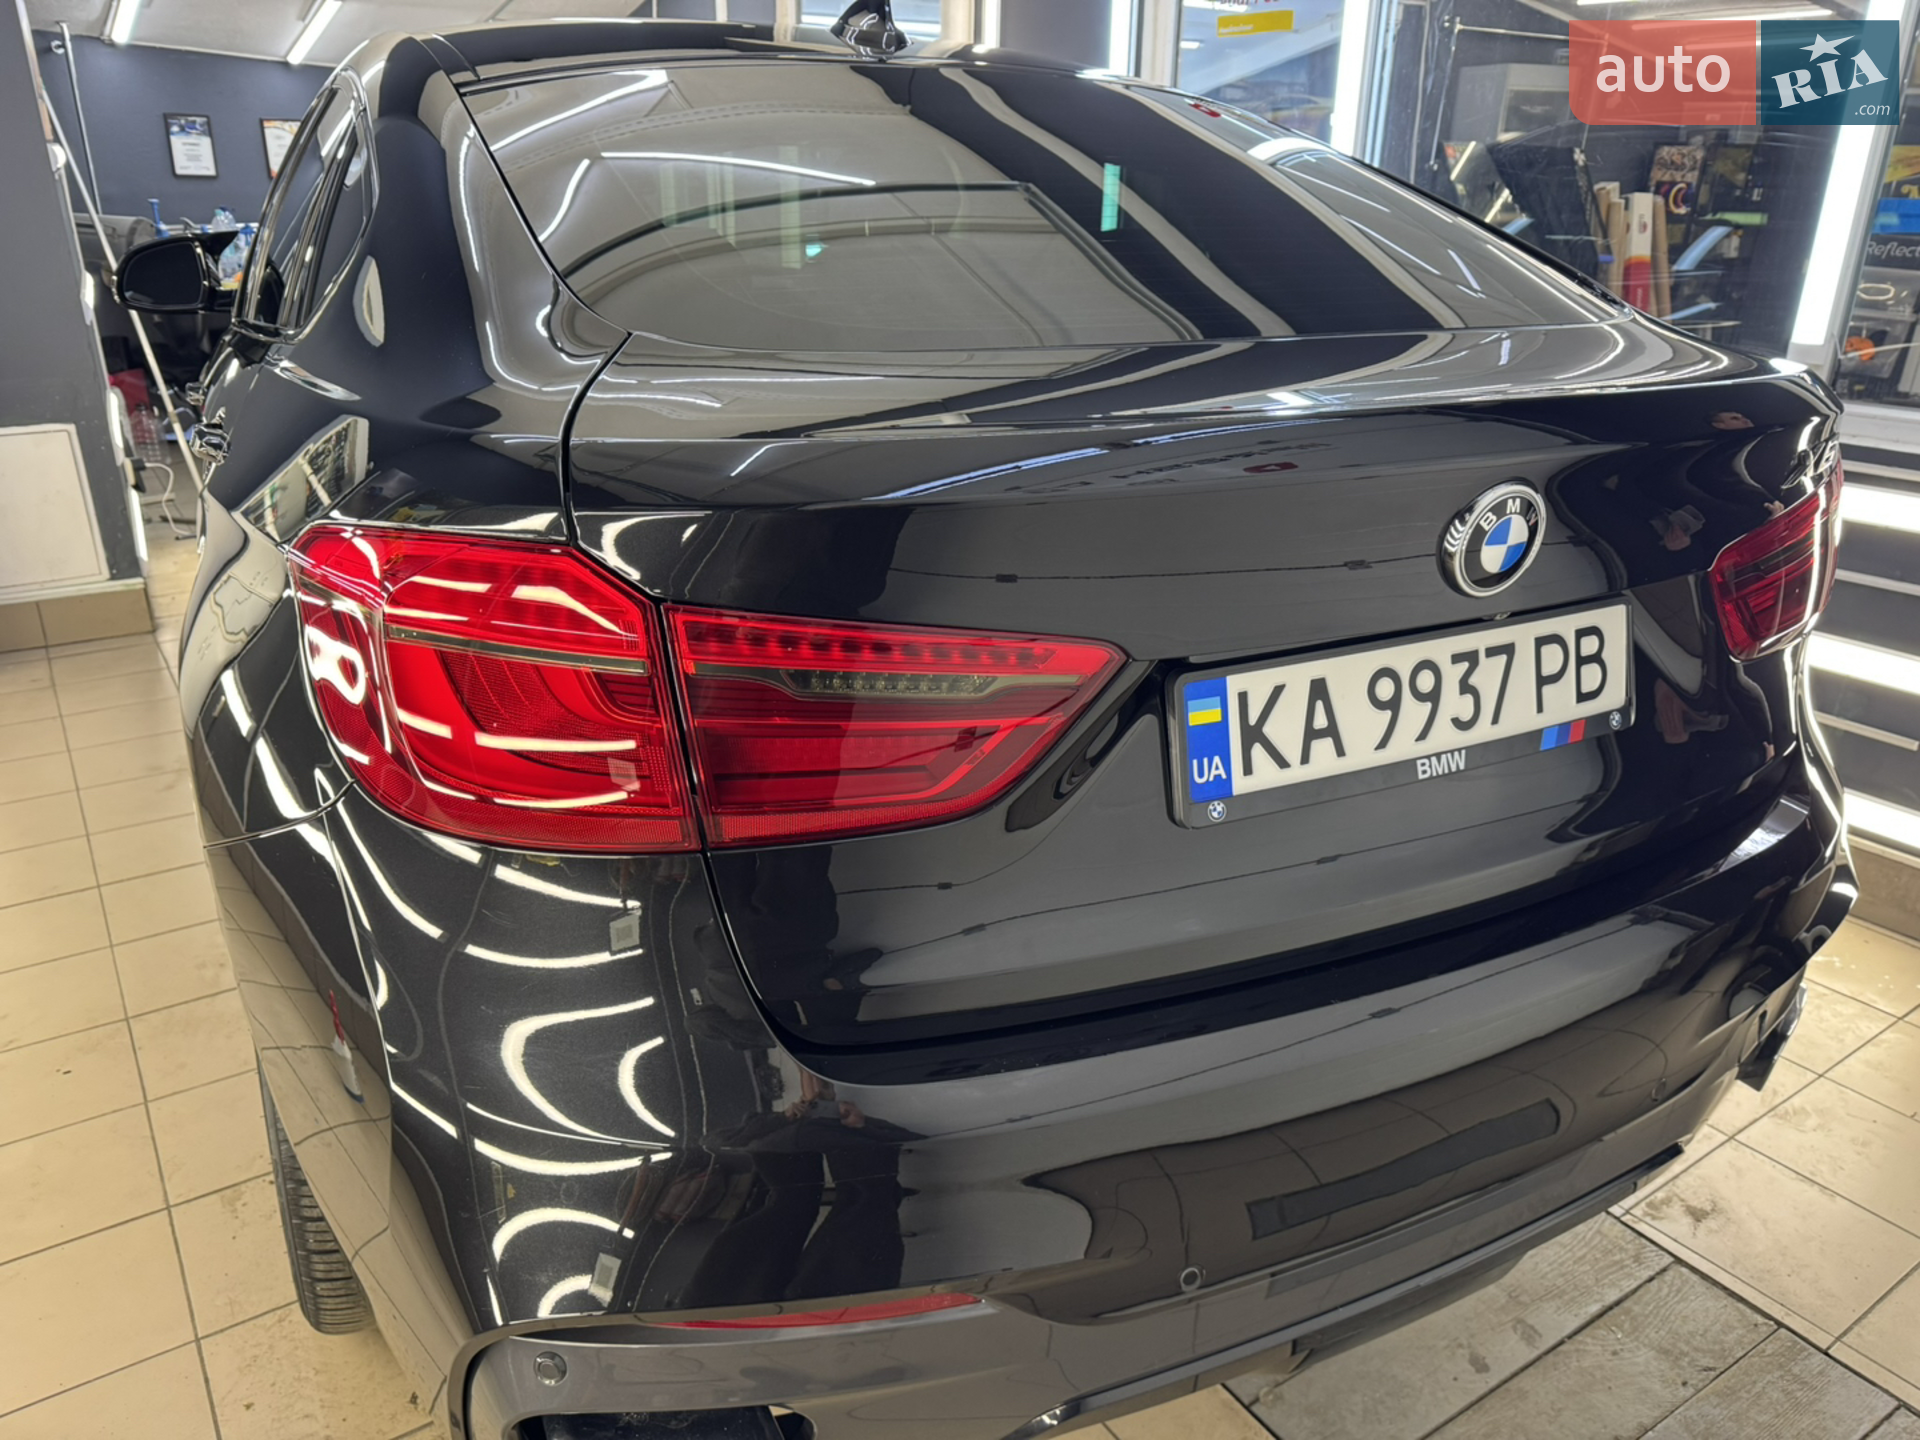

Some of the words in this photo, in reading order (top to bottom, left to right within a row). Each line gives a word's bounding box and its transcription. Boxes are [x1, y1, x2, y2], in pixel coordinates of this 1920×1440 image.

[1479, 497, 1538, 531] BMW
[1237, 677, 1346, 777] KA
[1366, 641, 1516, 751] 9937
[1534, 625, 1608, 715] PB
[1192, 754, 1227, 785] UA
[1415, 749, 1467, 781] BMW
